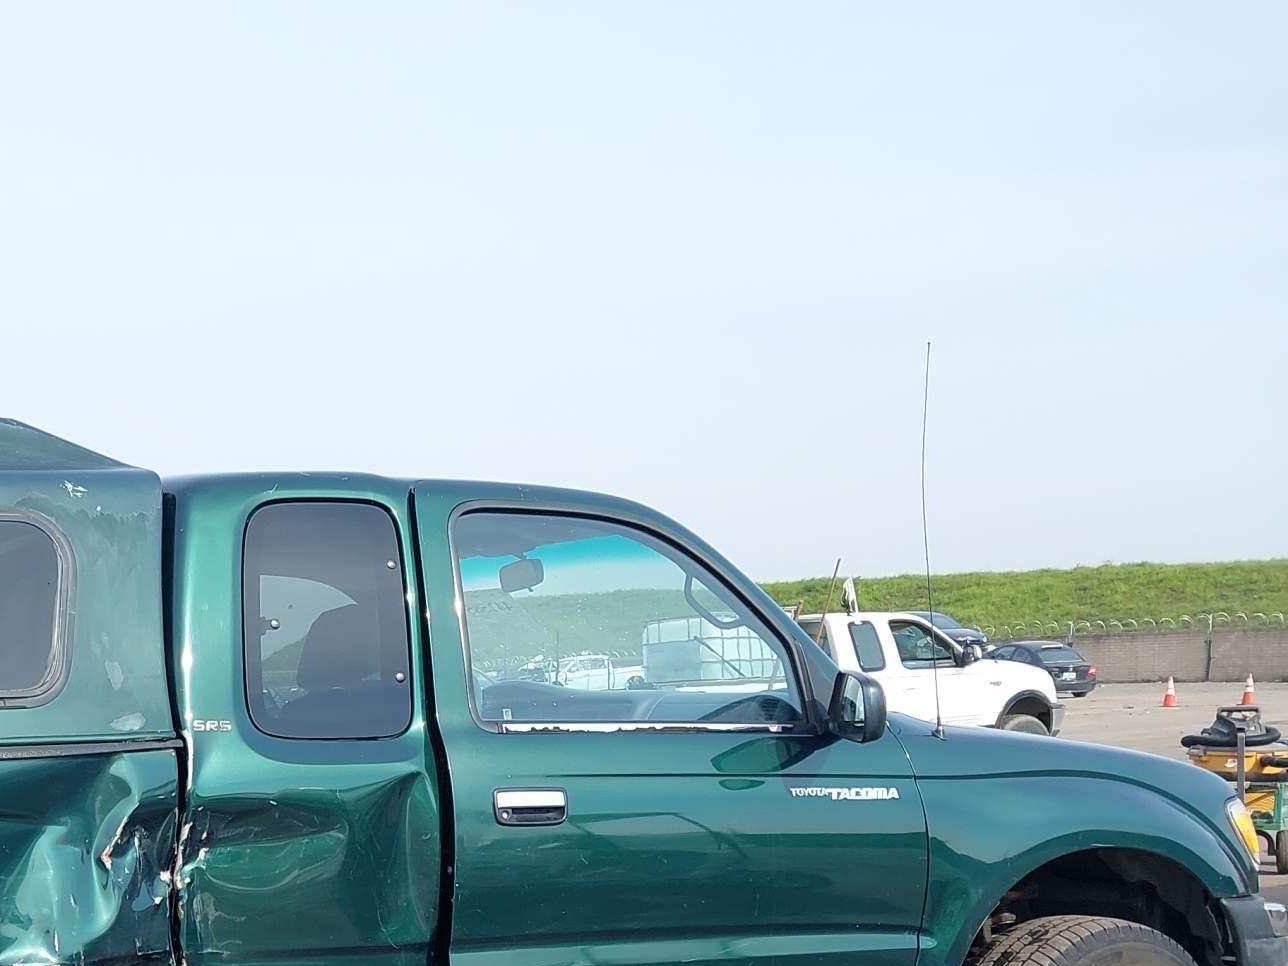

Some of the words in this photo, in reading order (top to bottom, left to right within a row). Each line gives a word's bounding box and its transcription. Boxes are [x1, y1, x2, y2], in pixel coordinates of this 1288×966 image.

[193, 719, 232, 732] SR5
[790, 787, 827, 797] TOYOTA
[827, 788, 900, 800] TACOMA
